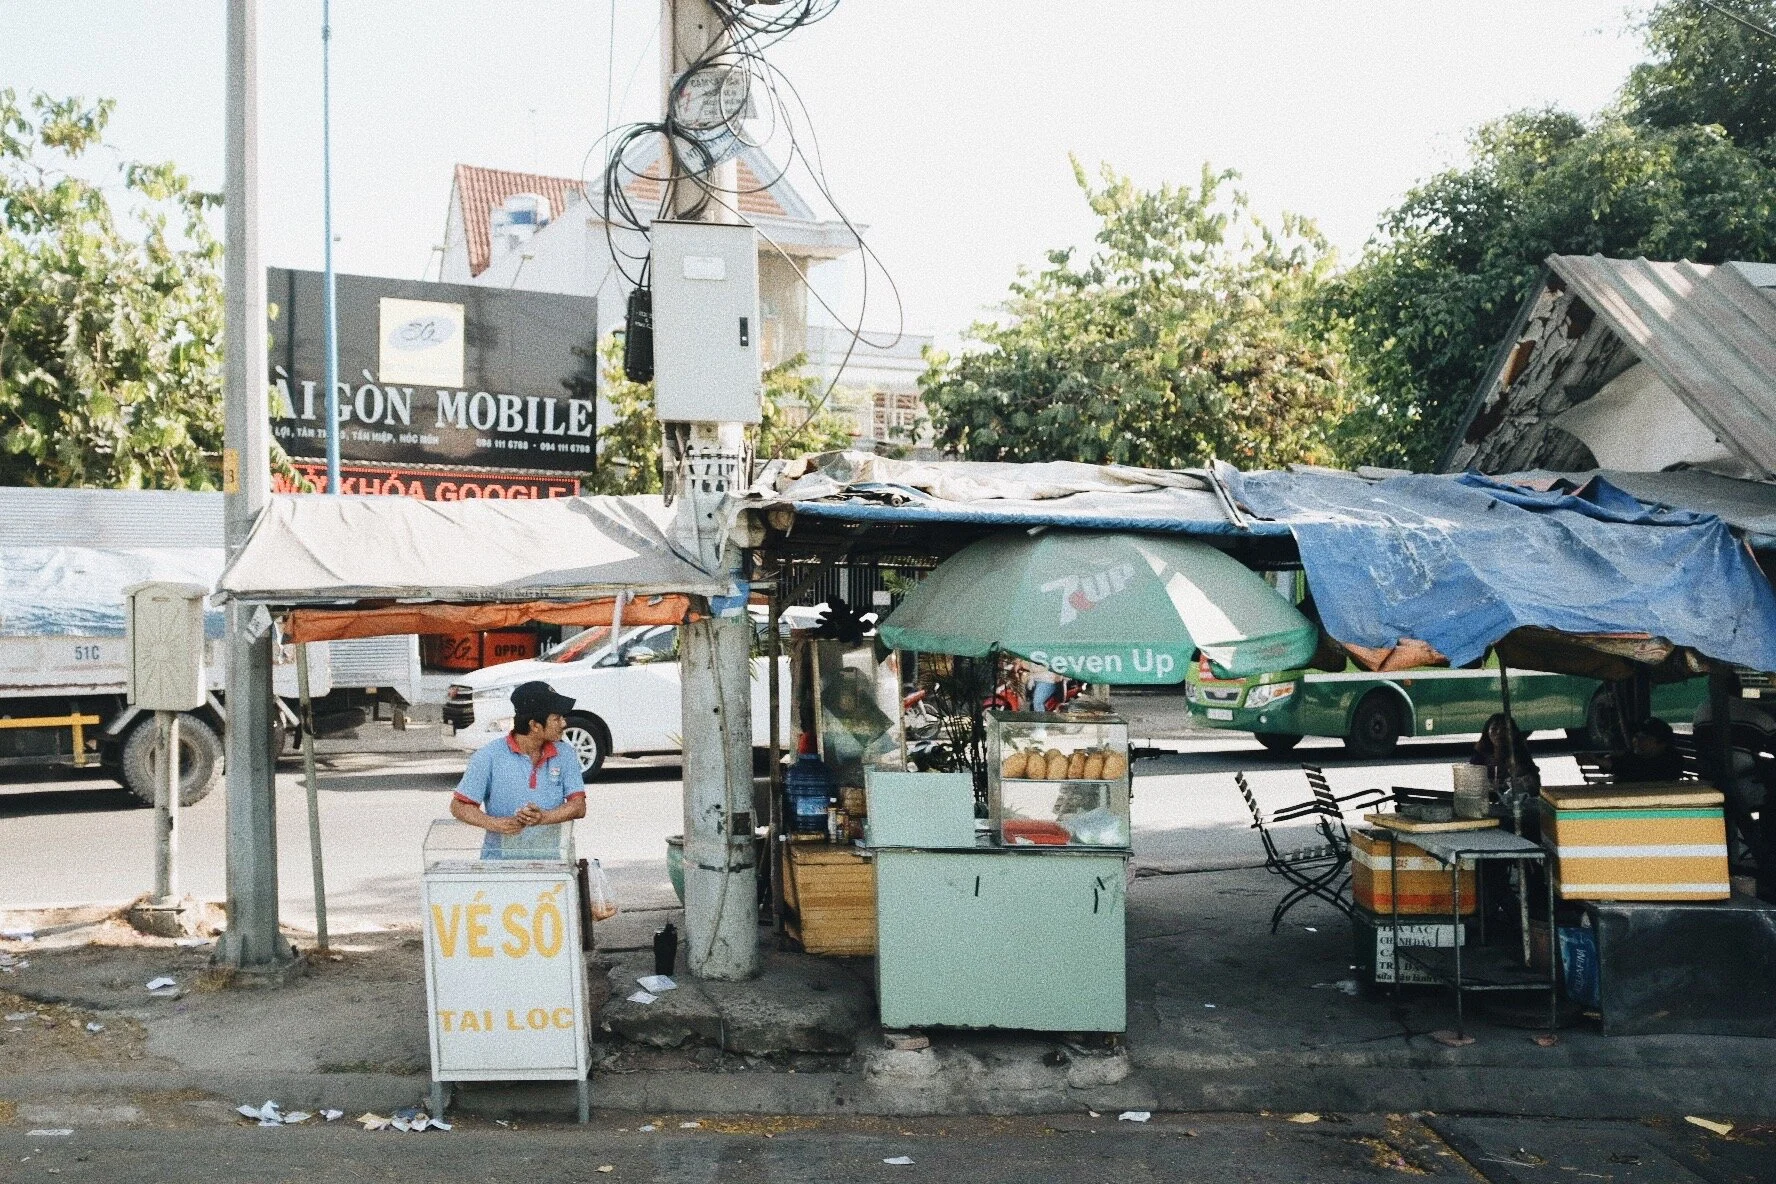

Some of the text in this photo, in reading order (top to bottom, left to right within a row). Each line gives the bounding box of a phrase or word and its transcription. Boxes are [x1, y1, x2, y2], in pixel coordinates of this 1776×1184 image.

[269, 365, 317, 420] ÀI
[435, 390, 593, 437] MOBILE
[340, 473, 426, 500] KHÓA
[74, 645, 100, 661] 51C
[494, 644, 526, 657] OPPO
[1029, 648, 1175, 678] Seven Up
[431, 883, 565, 959] VÉ SỐ
[438, 1006, 575, 1034] TAI LOC
